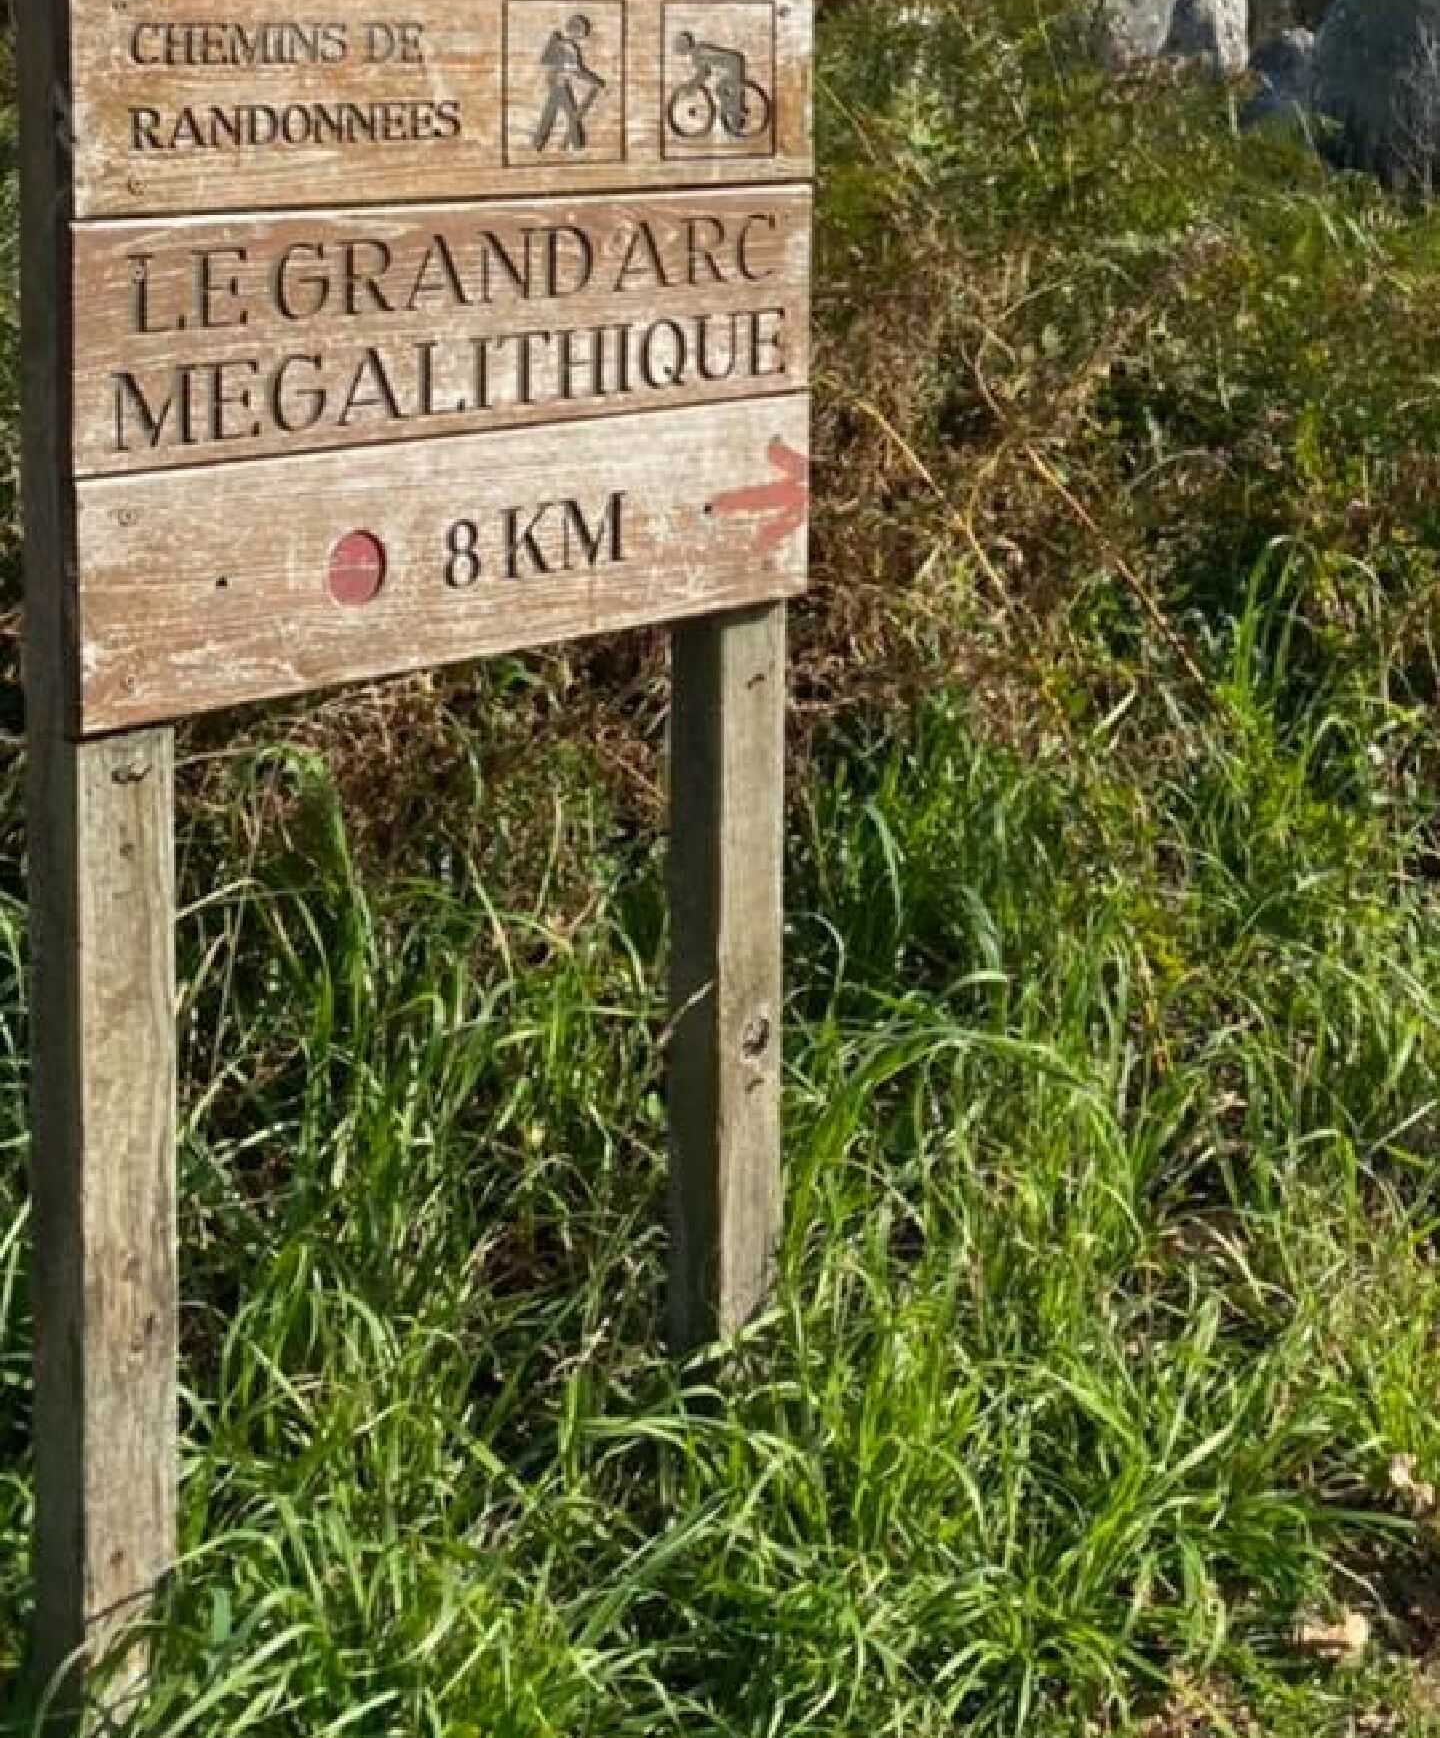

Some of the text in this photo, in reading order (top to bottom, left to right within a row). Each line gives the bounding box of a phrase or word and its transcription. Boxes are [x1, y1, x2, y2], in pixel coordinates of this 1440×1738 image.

[129, 21, 425, 66] CHEMINS DE
[128, 101, 463, 151] RANDONNEES
[127, 213, 778, 334] LE GRAND ARC
[111, 307, 787, 450] MEGALITHIQUE
